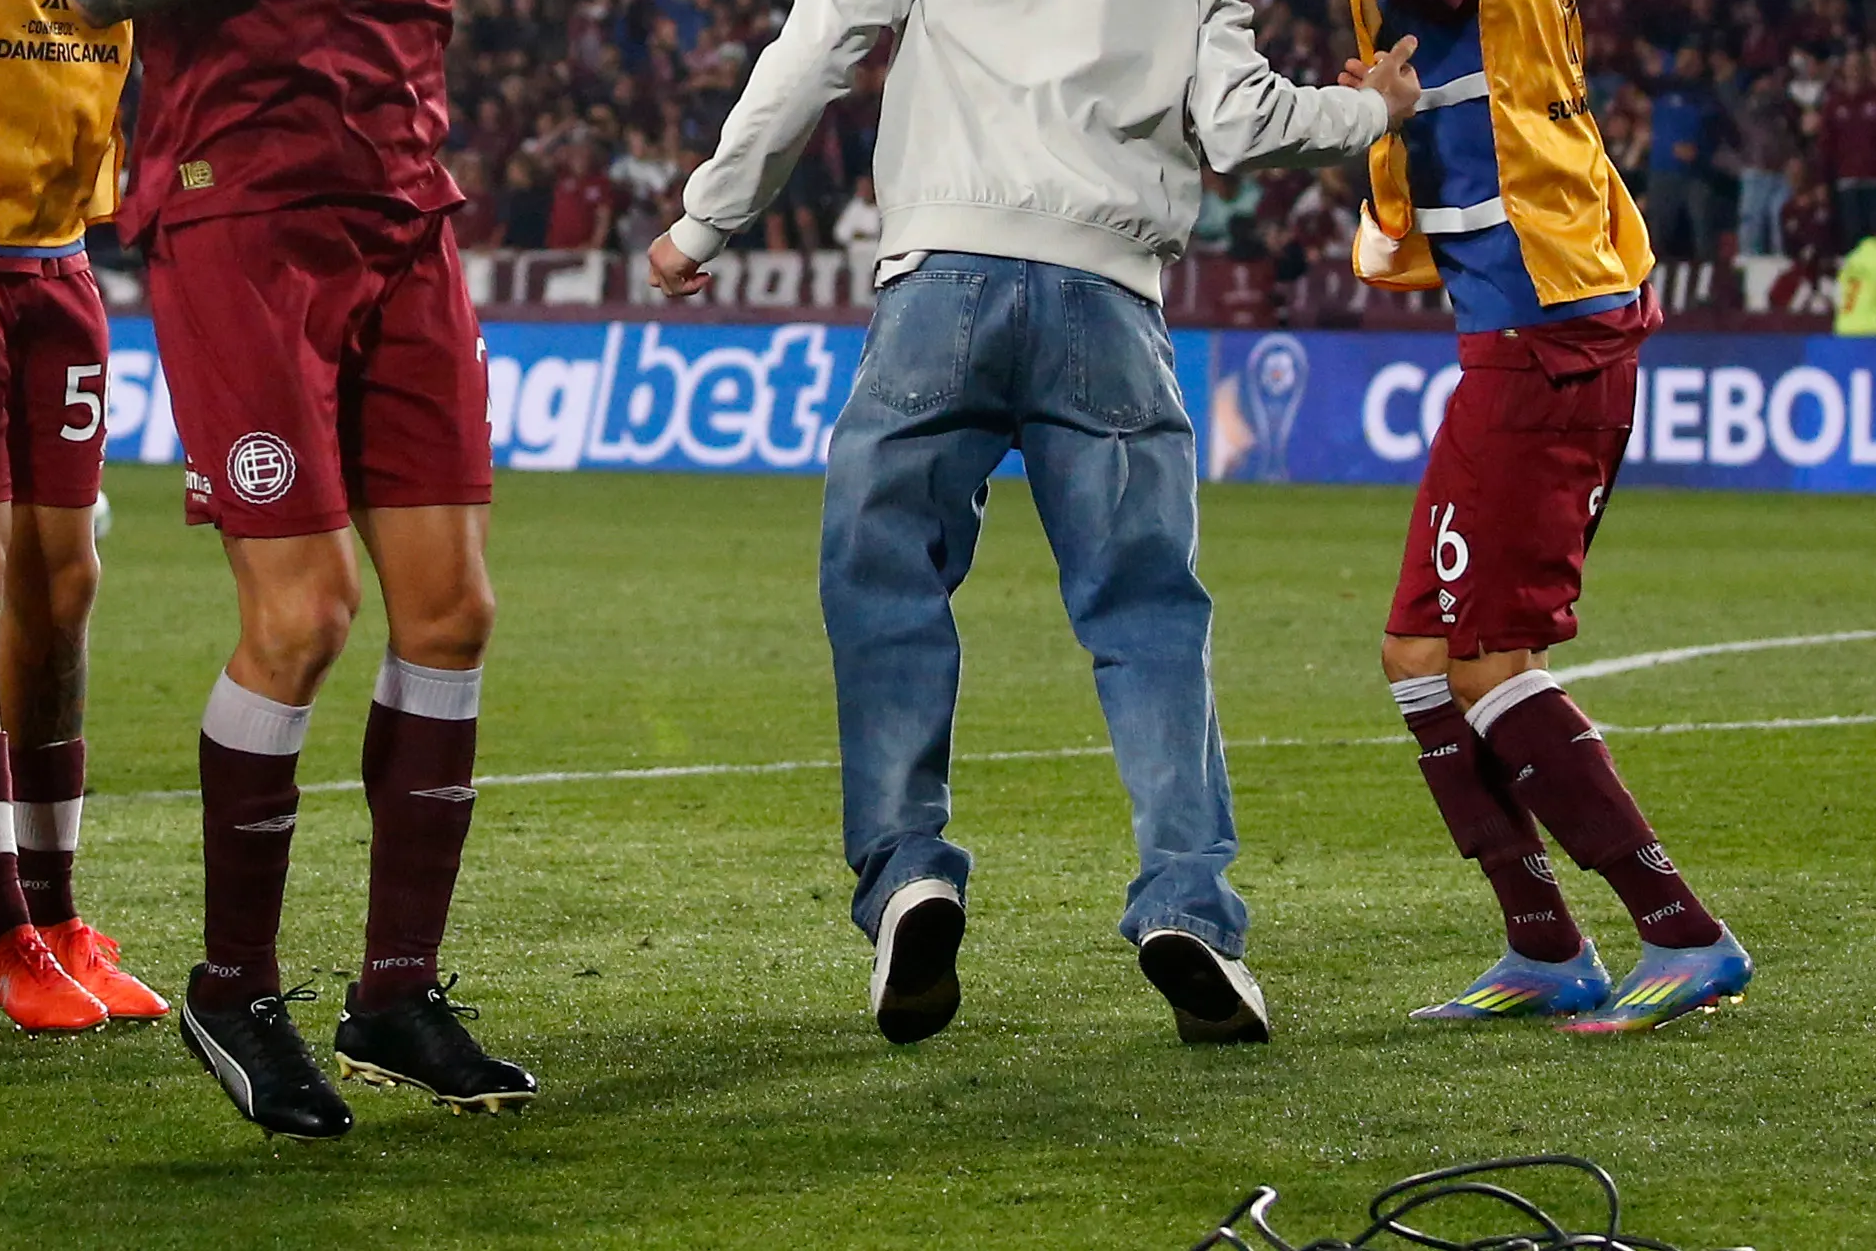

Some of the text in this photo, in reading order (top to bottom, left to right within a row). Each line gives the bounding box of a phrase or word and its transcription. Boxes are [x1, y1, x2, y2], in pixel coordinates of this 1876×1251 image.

[1512, 909, 1557, 925] TIFOX
[1642, 900, 1686, 926] TIFOX
[371, 956, 426, 972] TIFOX
